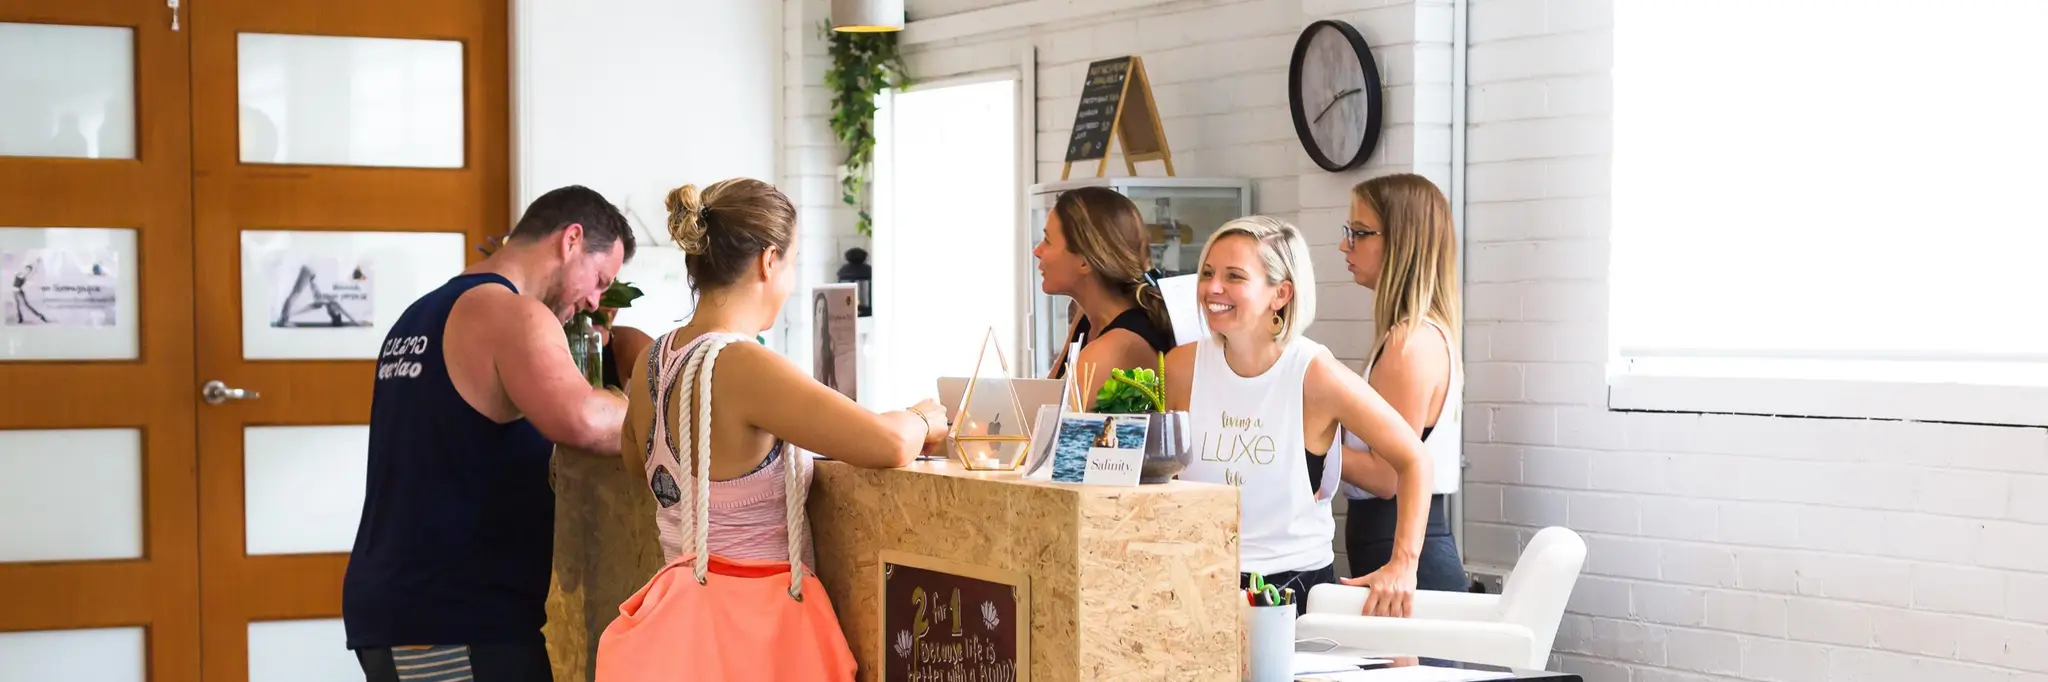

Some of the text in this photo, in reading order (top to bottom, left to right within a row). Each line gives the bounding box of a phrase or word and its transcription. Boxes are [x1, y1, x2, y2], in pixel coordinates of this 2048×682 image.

[1221, 409, 1264, 432] living a
[1090, 459, 1133, 476] Salinity.
[1225, 467, 1247, 487] life
[911, 586, 963, 639] 2 for 1
[965, 634, 983, 664] life
[986, 637, 996, 665] is
